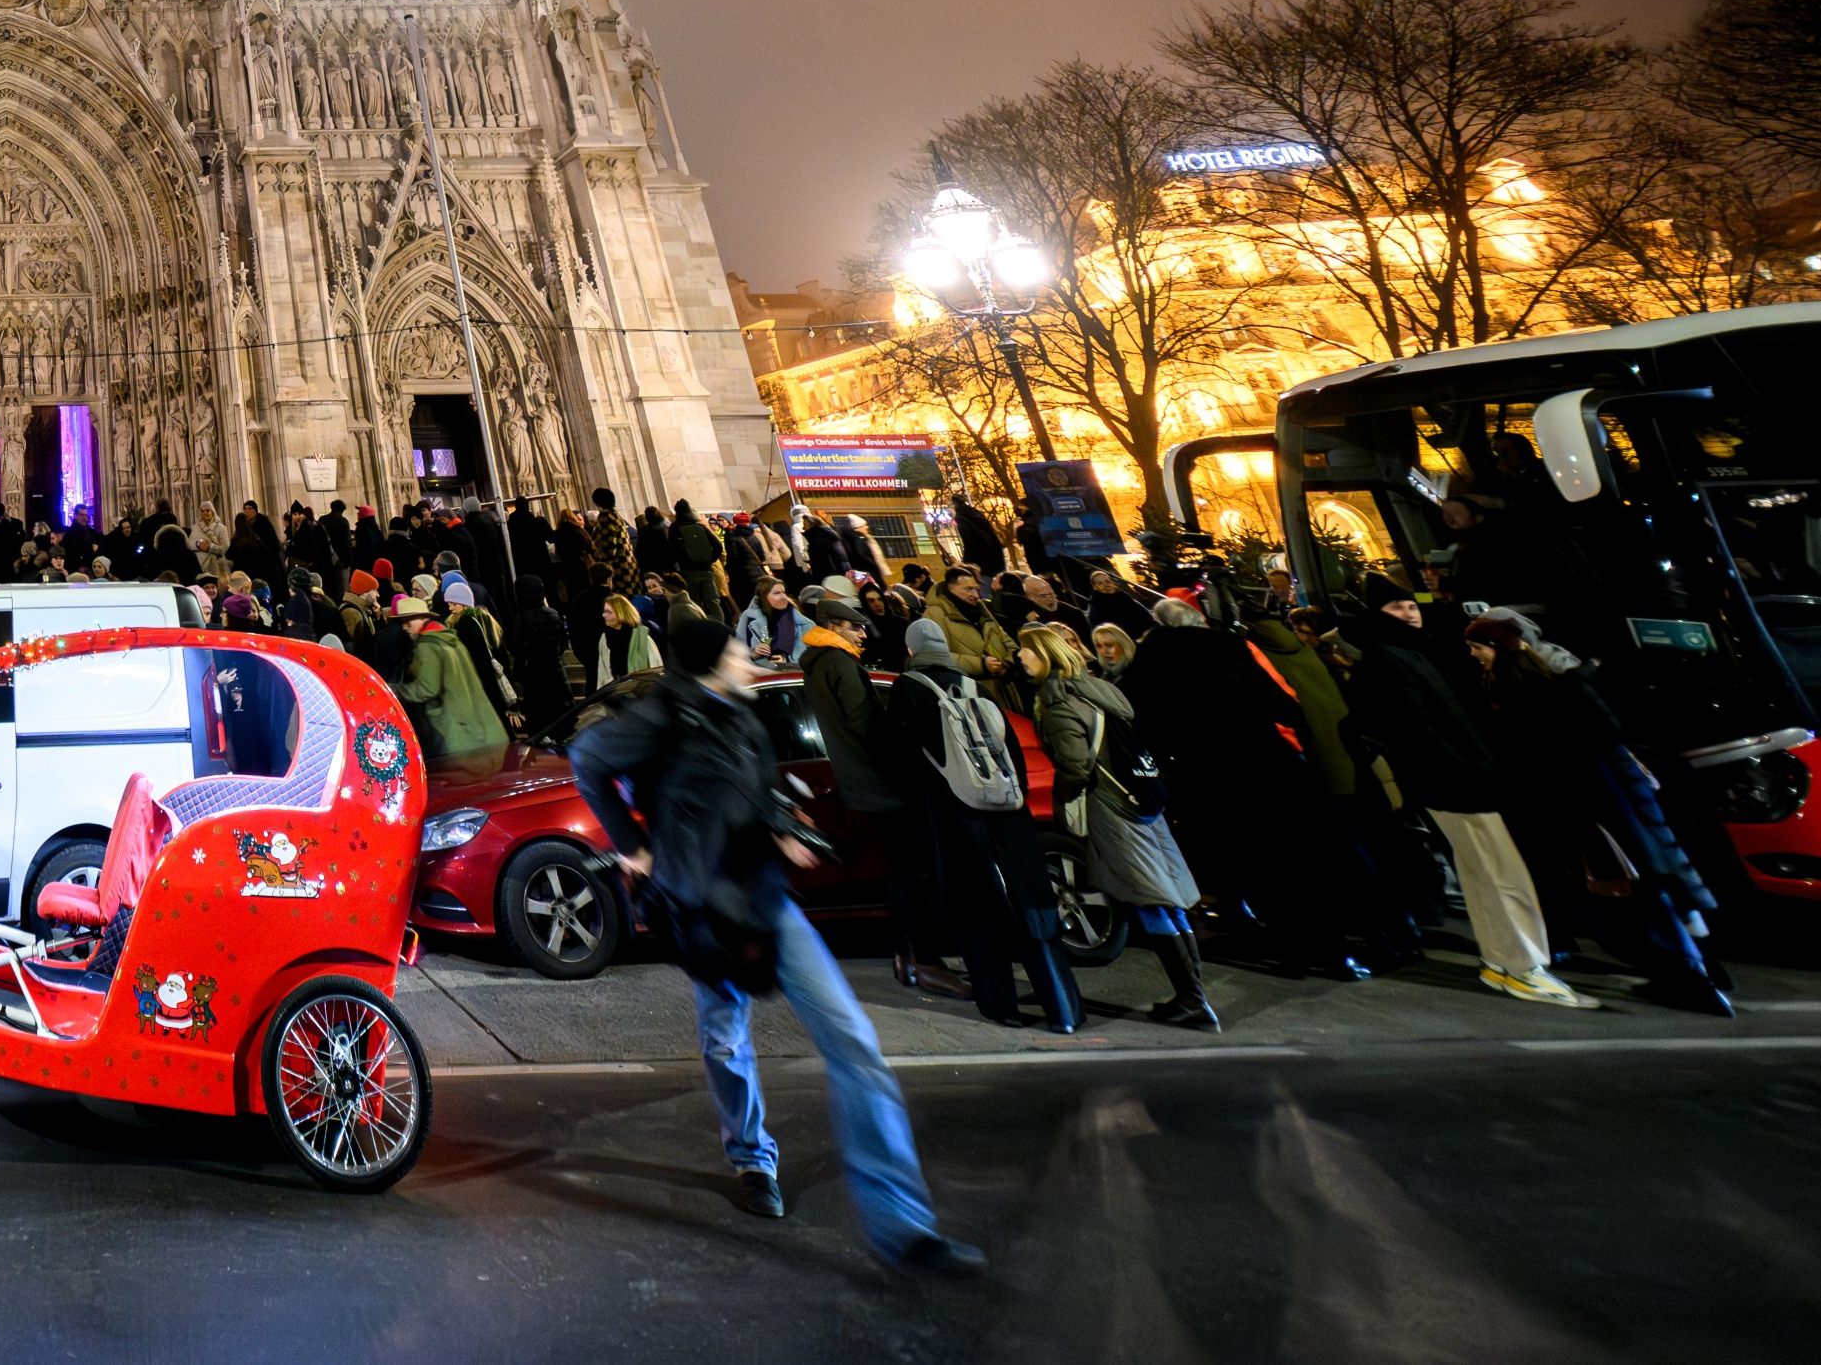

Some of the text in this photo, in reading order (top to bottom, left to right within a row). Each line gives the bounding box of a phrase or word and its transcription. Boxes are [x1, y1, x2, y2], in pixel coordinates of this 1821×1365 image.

[1166, 145, 1326, 172] HOTEL REGINA
[864, 438, 886, 446] direkt
[902, 438, 927, 446] Bauern
[794, 478, 908, 488] HERZLICH WILLKOMMEN
